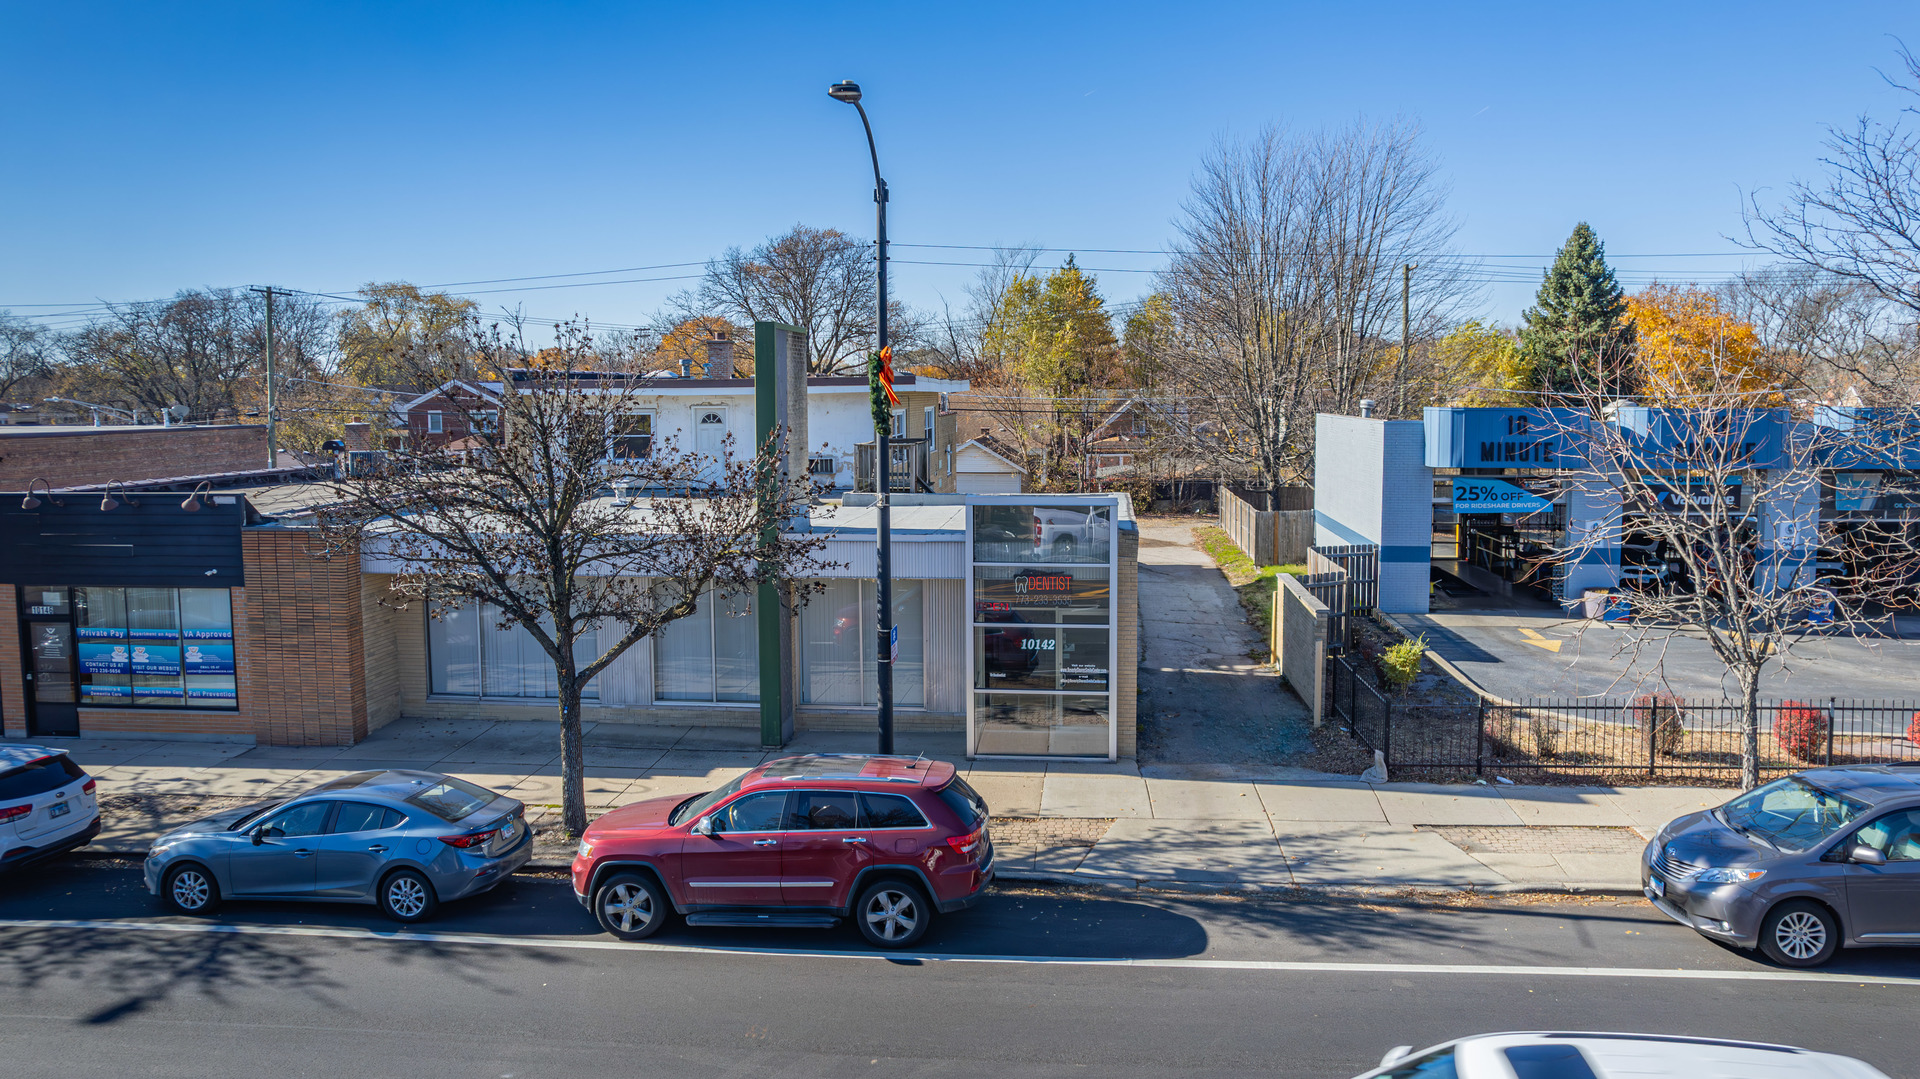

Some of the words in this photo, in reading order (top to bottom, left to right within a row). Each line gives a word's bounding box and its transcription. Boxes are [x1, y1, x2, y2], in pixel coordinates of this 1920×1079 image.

[1507, 415, 1528, 435] 10
[1480, 441, 1554, 462] MINUTE
[1455, 486, 1498, 501] 25%
[1501, 492, 1524, 501] OFF
[1028, 576, 1072, 591] DENTIST
[976, 602, 1009, 611] OPEN
[80, 629, 108, 637] Private
[110, 629, 124, 638] Pay
[195, 630, 232, 639] Approved
[1020, 638, 1056, 650] 10142
